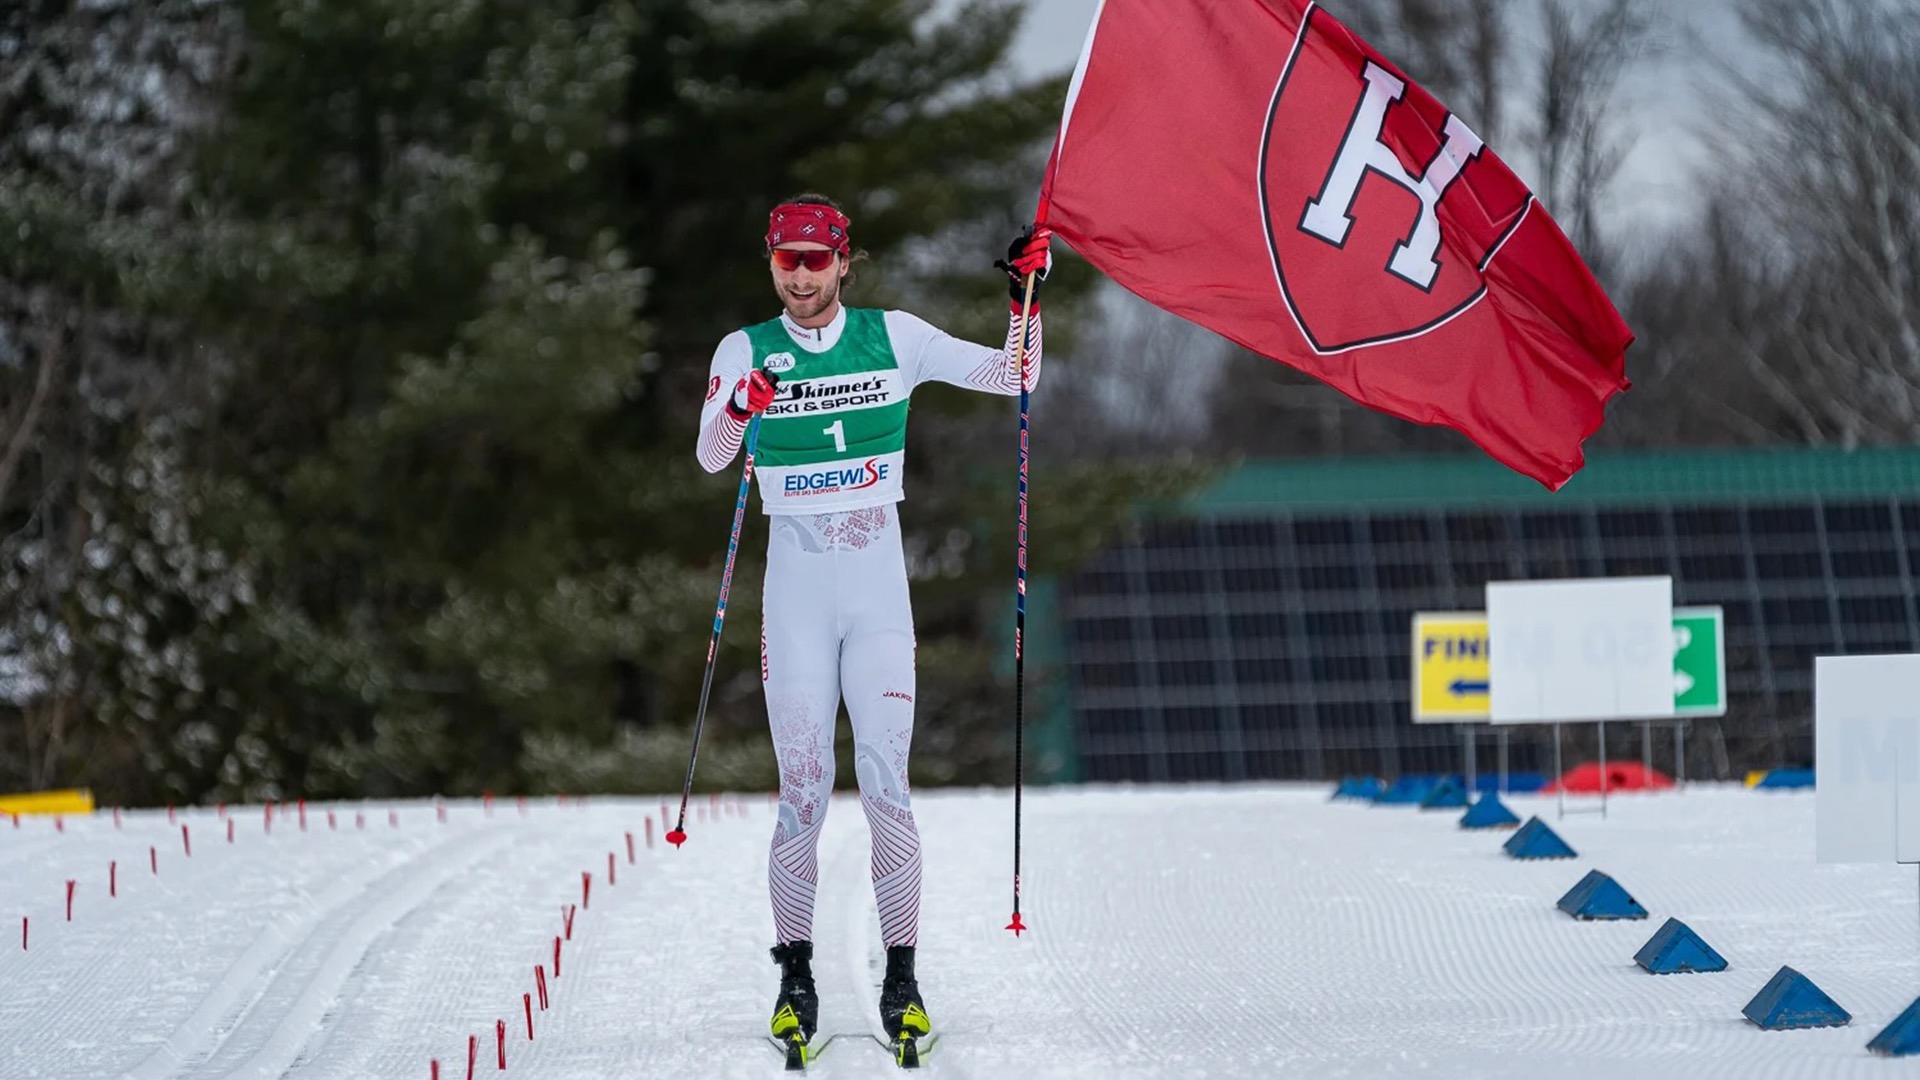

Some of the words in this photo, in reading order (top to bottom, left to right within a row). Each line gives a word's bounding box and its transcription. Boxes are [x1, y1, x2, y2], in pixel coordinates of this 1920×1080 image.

[1298, 58, 1486, 294] H
[790, 376, 888, 401] Skinner's
[765, 402, 799, 415] SKI
[803, 400, 820, 412] &
[821, 392, 890, 410] SPORT
[823, 419, 847, 453] 1
[783, 456, 890, 492] EDGEWISE
[783, 489, 801, 498] ELITE
[801, 488, 812, 496] SKI
[812, 485, 842, 496] SERVICE
